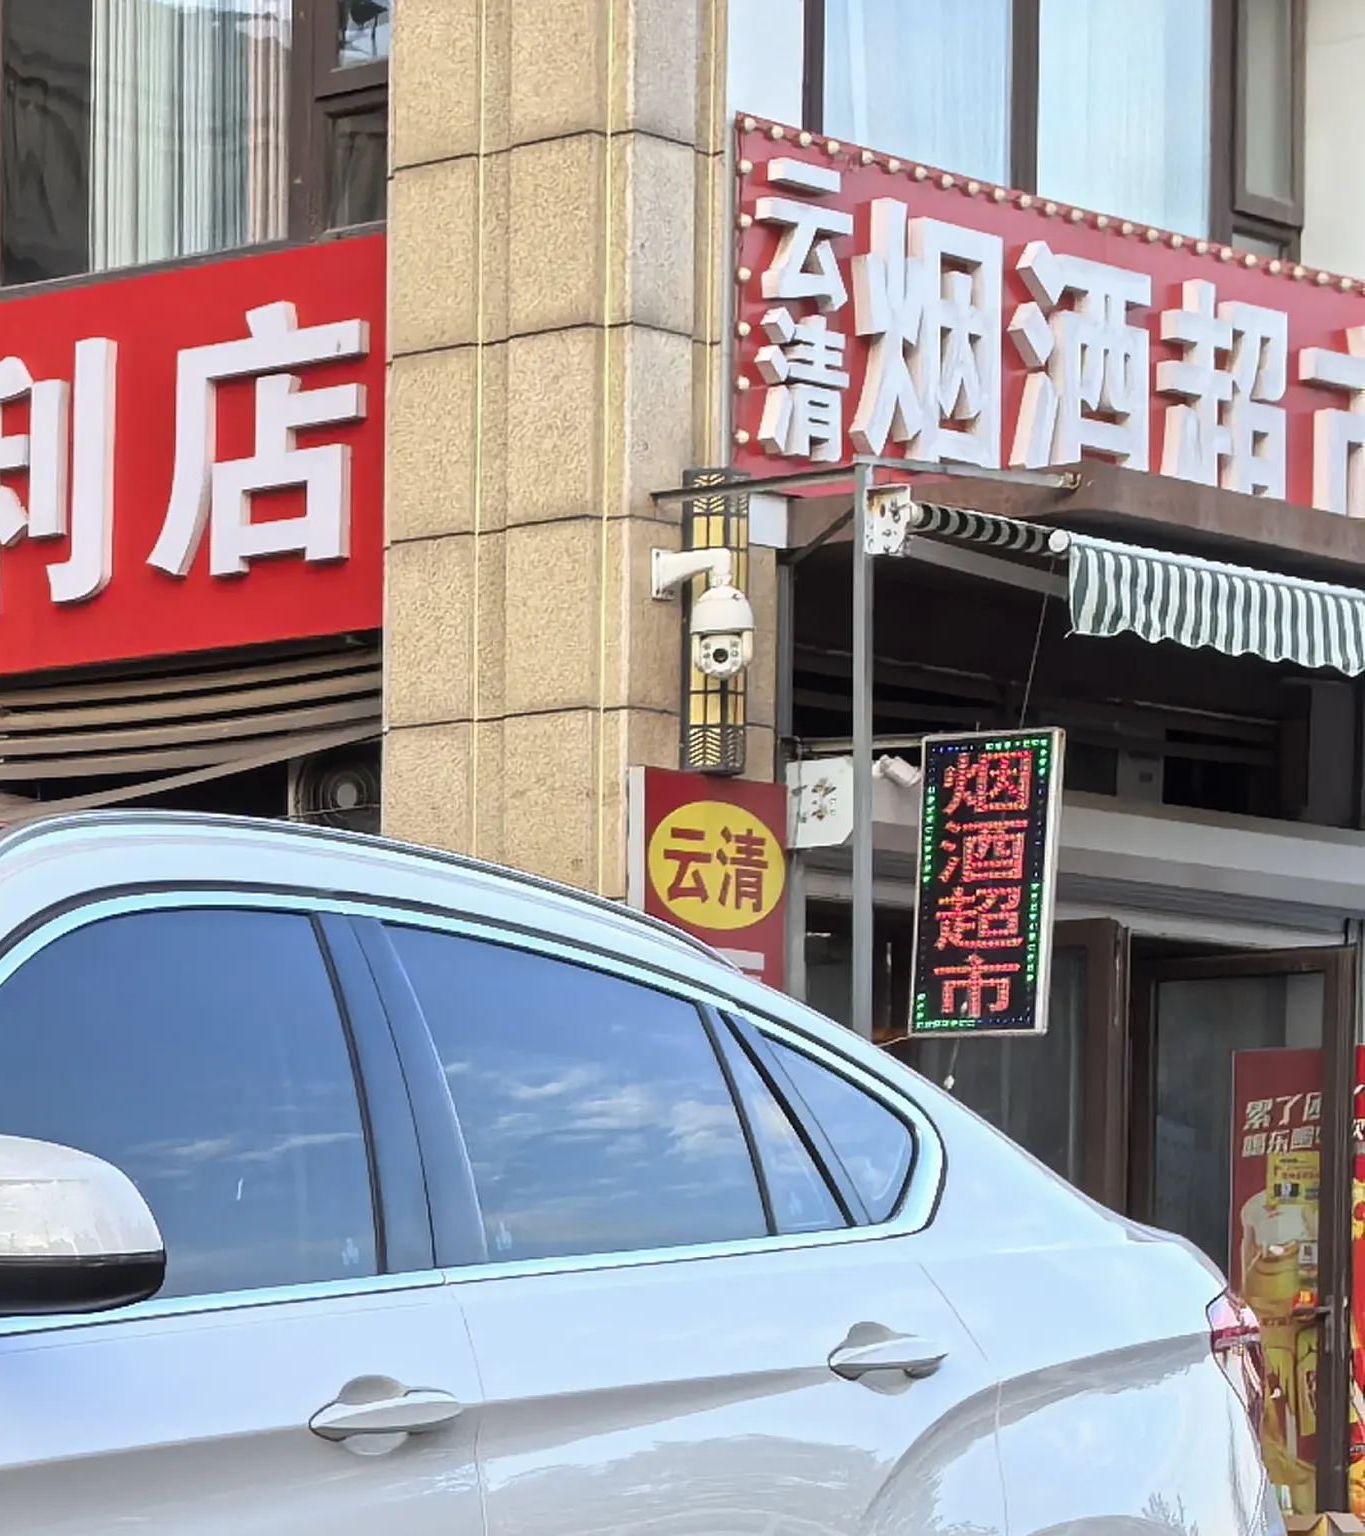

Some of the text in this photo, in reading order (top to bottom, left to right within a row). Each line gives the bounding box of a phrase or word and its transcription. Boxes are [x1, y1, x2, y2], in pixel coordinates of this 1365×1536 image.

[754, 156, 854, 463] 云清
[663, 825, 769, 914] 云清
[932, 750, 1034, 1019] 烟酒超市
